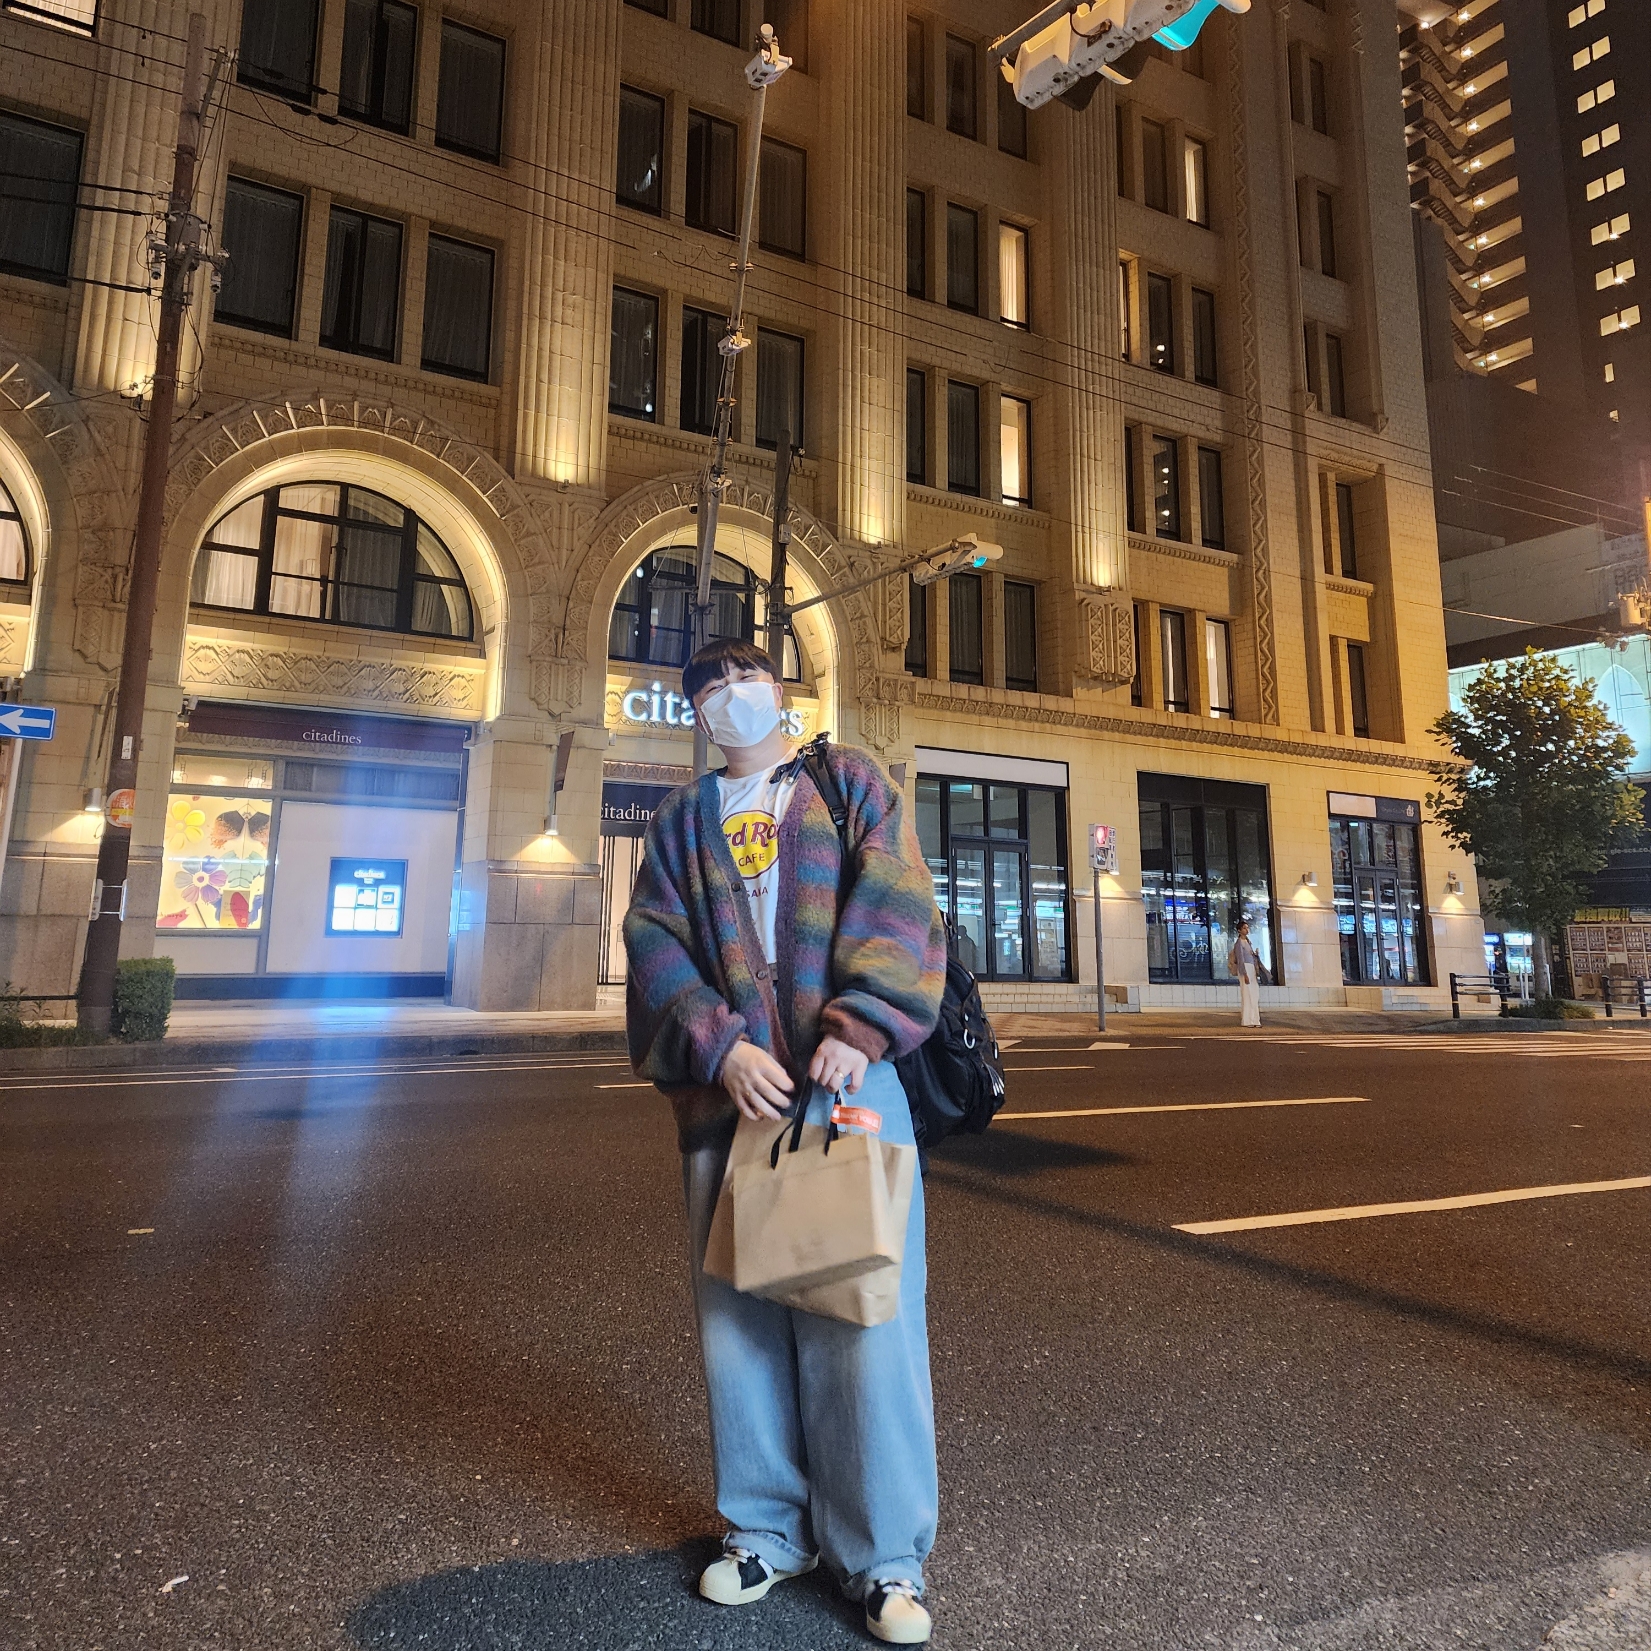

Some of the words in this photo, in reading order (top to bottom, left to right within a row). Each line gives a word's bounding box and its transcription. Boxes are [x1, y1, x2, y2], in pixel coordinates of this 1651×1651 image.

[623, 681, 803, 736] citas
[302, 729, 362, 744] citadines
[601, 802, 657, 821] itadine
[750, 821, 778, 848] Ro
[738, 853, 765, 867] CAFE
